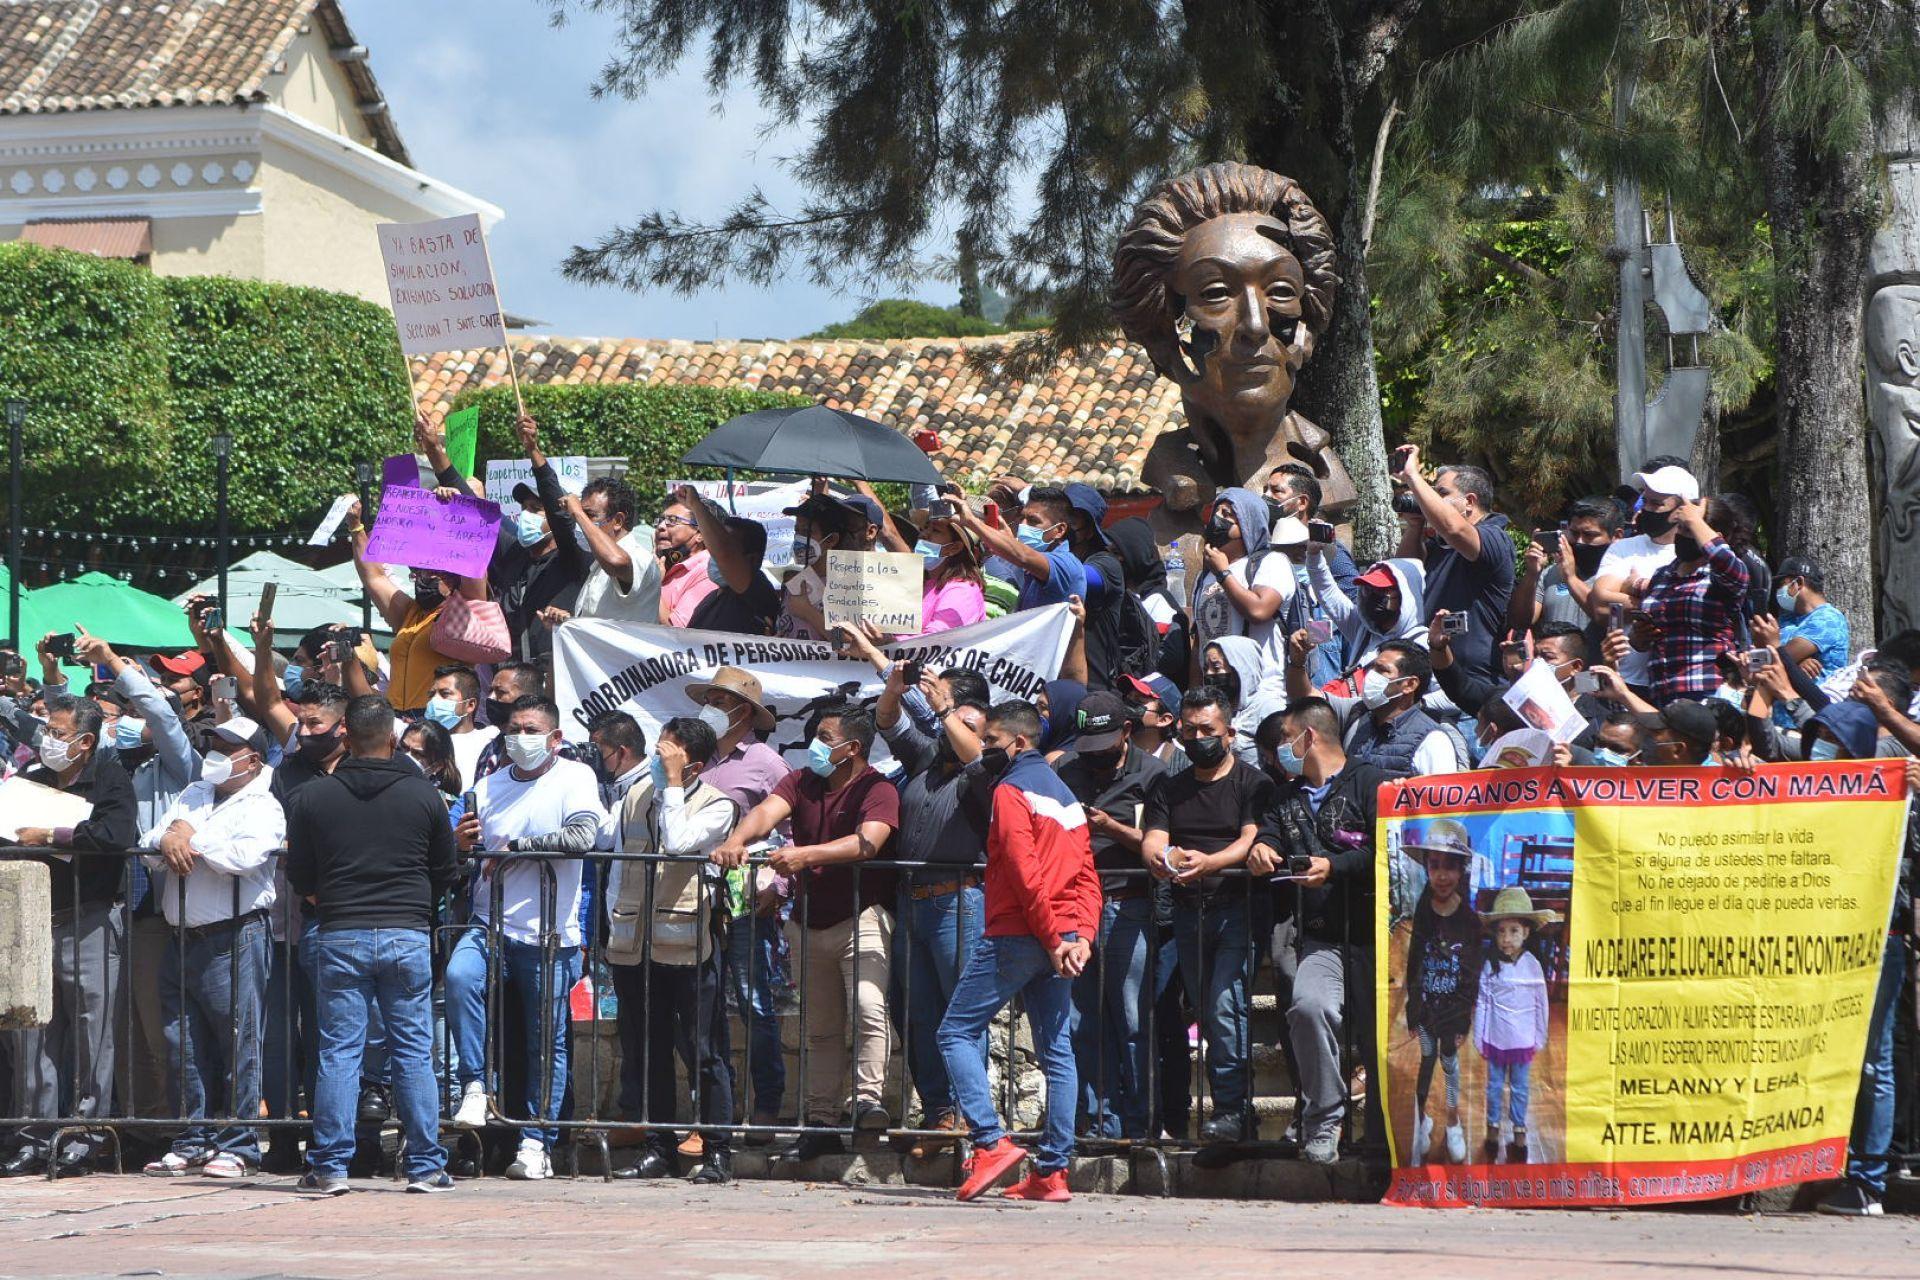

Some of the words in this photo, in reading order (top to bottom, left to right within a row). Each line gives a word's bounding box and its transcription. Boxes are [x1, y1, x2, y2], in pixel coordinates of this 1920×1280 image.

[410, 233, 455, 255] BASTA
[463, 228, 479, 246] DE
[406, 322, 442, 341] SECCION
[441, 318, 451, 333] 7
[829, 555, 862, 575] Respeto
[866, 565, 874, 573] a
[877, 561, 898, 575] los
[572, 648, 700, 731] COORDINADORA
[703, 643, 729, 668] DE
[735, 641, 831, 665] PERSONAS
[961, 648, 990, 673] DE
[1394, 778, 1540, 811] AYUDANOS
[1545, 778, 1567, 800] A
[1572, 777, 1700, 801] VOLVER
[1711, 777, 1778, 800] CON
[1788, 766, 1888, 797] MAMÁ
[1658, 831, 1676, 846] No
[1679, 832, 1718, 850] puedo
[1721, 830, 1770, 845] asimilar
[1772, 829, 1784, 844] la
[1788, 828, 1815, 844] vida
[1649, 852, 1691, 871] alguna
[1695, 852, 1711, 867] de
[1714, 852, 1764, 867] ustedes
[1766, 854, 1787, 866] me
[1637, 874, 1655, 890] No
[1658, 874, 1675, 889] he
[1677, 874, 1720, 892] dejado
[1723, 874, 1740, 889] de
[1743, 872, 1787, 891] pedirle
[1790, 876, 1799, 889] a
[1802, 871, 1831, 888] Dios
[1611, 899, 1632, 916] que
[1635, 895, 1646, 911] al
[1650, 895, 1664, 911] fin
[1668, 895, 1705, 914] llegue
[1708, 895, 1719, 910] el
[1746, 896, 1771, 913] que
[1774, 895, 1814, 914] pueda
[1586, 938, 1605, 978] NO
[1607, 936, 1656, 978] DEJARE
[1659, 936, 1677, 977] DE
[1680, 934, 1736, 977] LUCHAR
[1739, 934, 1782, 976] HASTA
[1785, 926, 1882, 976] ENCONTRARLAS
[1572, 1008, 1583, 1031] MI
[1623, 1002, 1672, 1031] CORAZÓN
[1672, 1006, 1681, 1029] Y
[1683, 1005, 1710, 1030] ALMA
[1712, 1004, 1757, 1030] SIEMPRE
[1609, 1040, 1627, 1065] LAS
[1629, 1040, 1650, 1065] AMO
[1652, 1040, 1661, 1064] Y
[1662, 1040, 1704, 1064] ESPERO
[1706, 1039, 1749, 1064] PRONTO
[1751, 1038, 1798, 1063] ESTEMOS
[1620, 1077, 1728, 1095] MELANNY
[1733, 1077, 1748, 1094] Y
[1753, 1071, 1800, 1094] LEHA
[1601, 1121, 1661, 1145] ATTE.
[1669, 1114, 1735, 1144] MAMÁ
[1740, 1105, 1825, 1141] BERANDA
[1461, 1173, 1511, 1208] alguien
[1514, 1178, 1533, 1199] ve
[1535, 1177, 1546, 1199] a
[1549, 1172, 1577, 1199] mis
[1629, 1169, 1724, 1198] comunicarse
